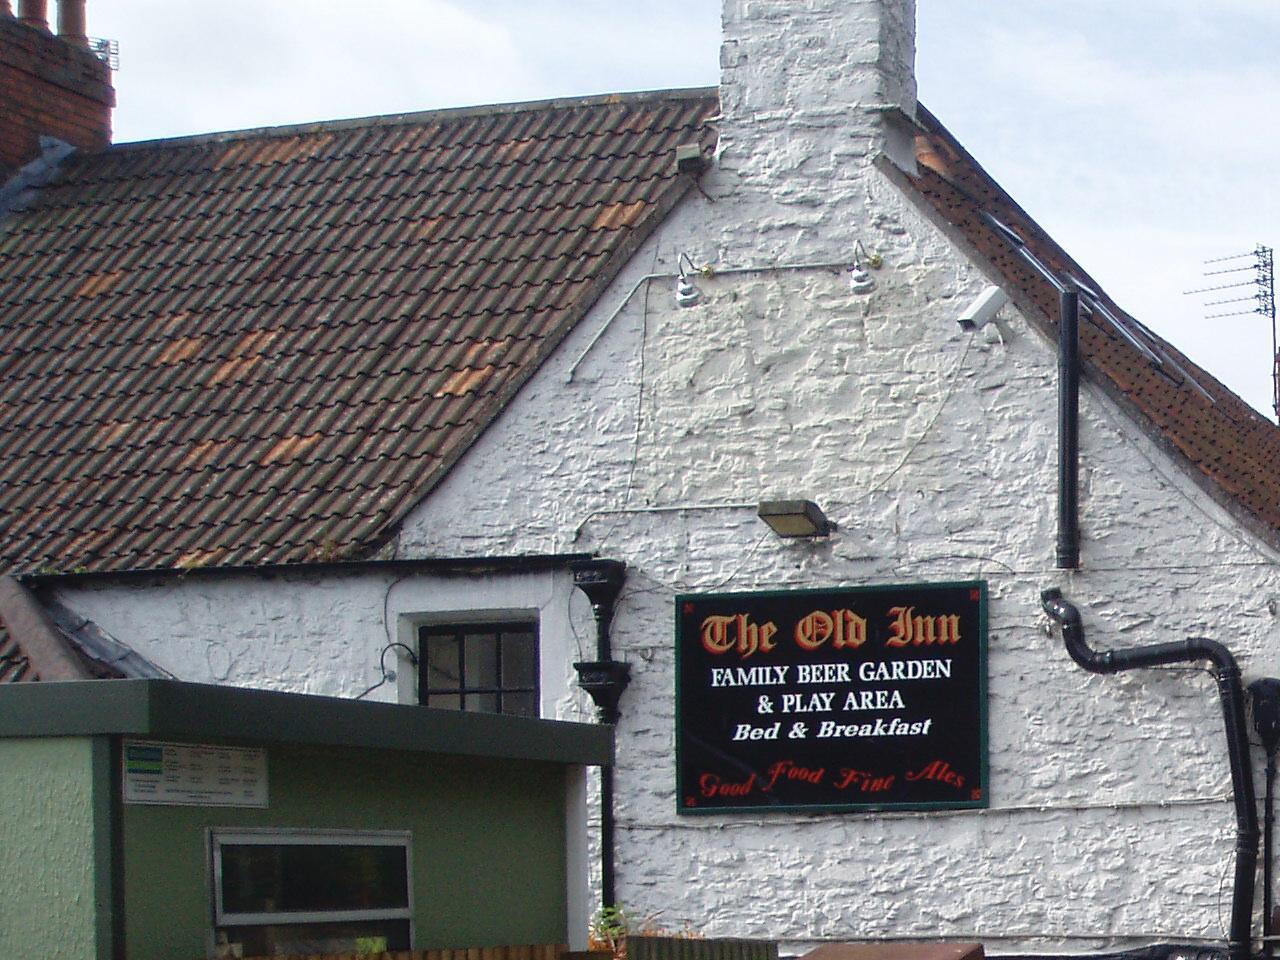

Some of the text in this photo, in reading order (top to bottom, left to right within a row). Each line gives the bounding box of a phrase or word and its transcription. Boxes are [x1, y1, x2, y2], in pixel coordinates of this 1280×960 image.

[701, 605, 962, 659] The Old Inn
[711, 659, 952, 687] FAMILY BEER GARDEN
[757, 690, 906, 714] & PLAY AREA
[732, 718, 932, 741] Bed & Breakfast
[699, 759, 966, 798] Good Food Fine Ales
